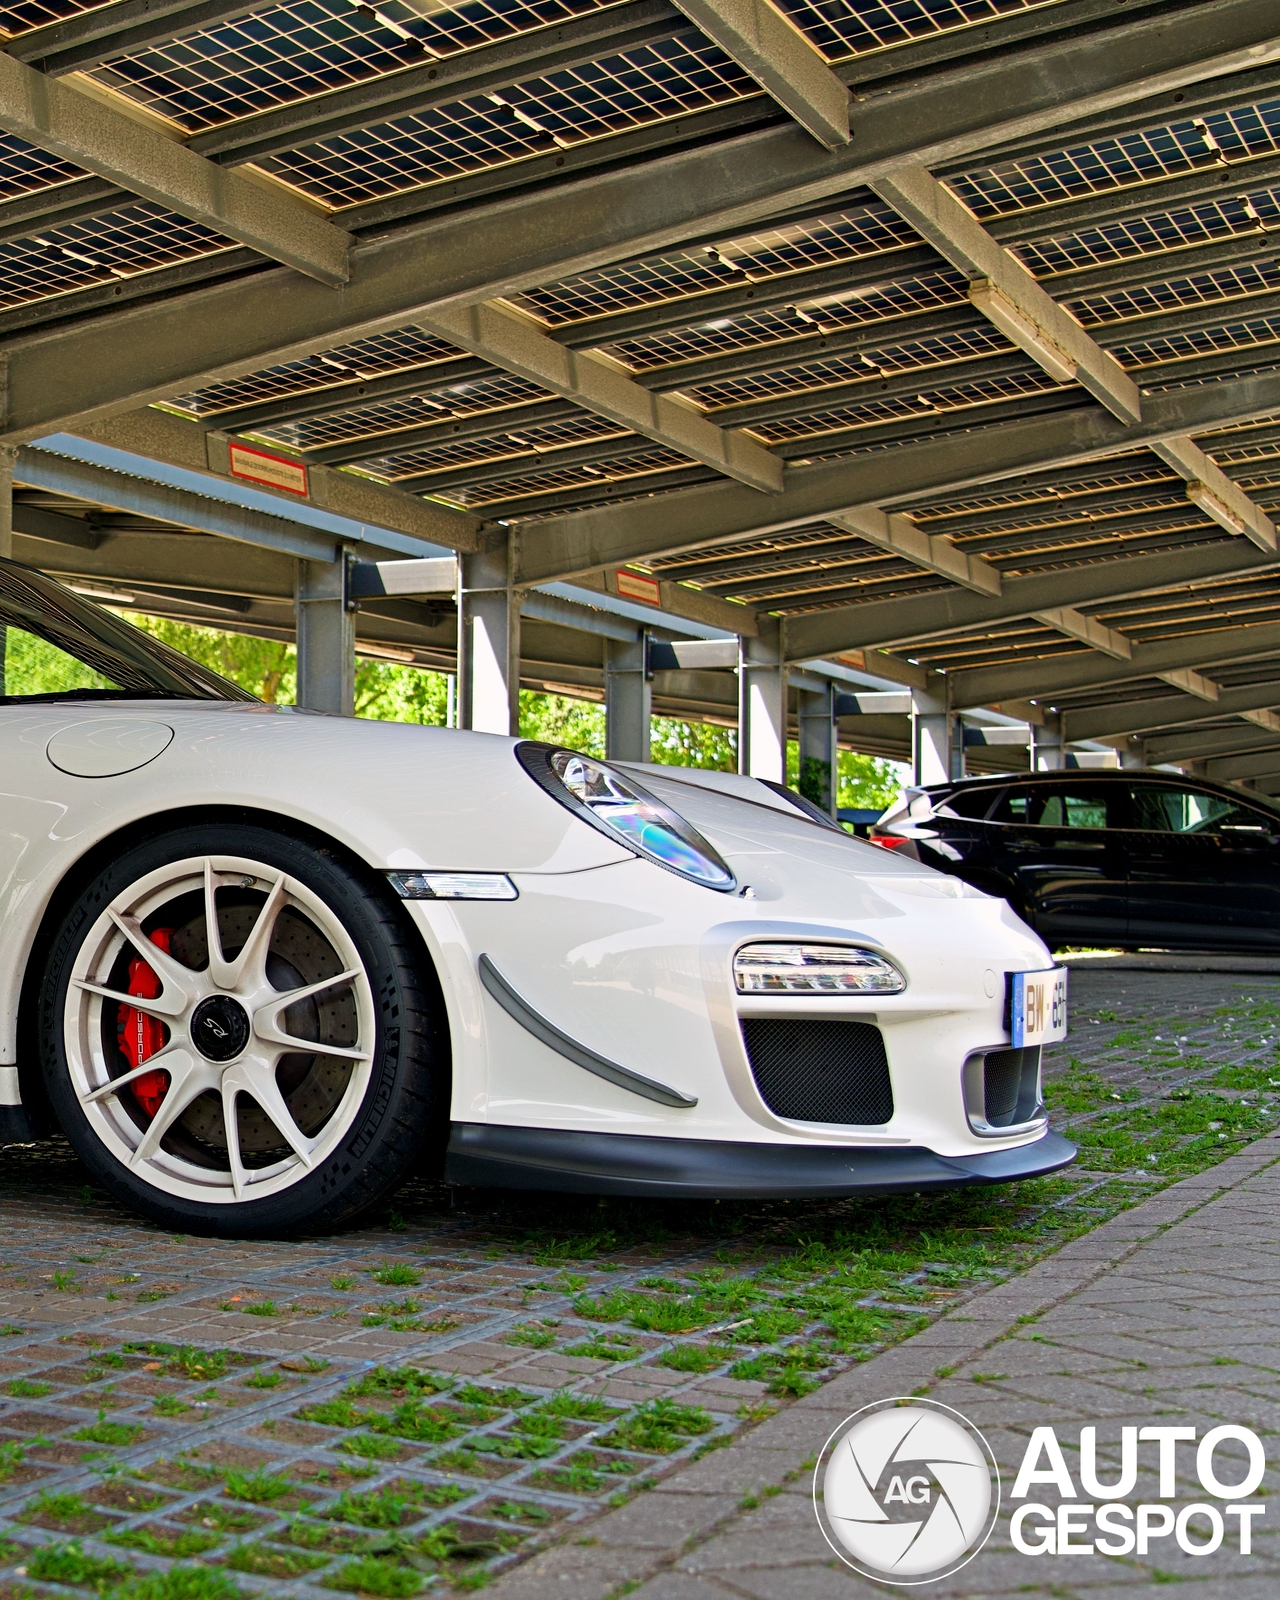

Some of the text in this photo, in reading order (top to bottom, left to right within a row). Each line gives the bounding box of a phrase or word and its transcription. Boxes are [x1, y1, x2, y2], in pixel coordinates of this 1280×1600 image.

[44, 906, 87, 1005] MICHELIN
[136, 992, 144, 1065] PORSCE
[348, 1055, 398, 1157] MICHELIN
